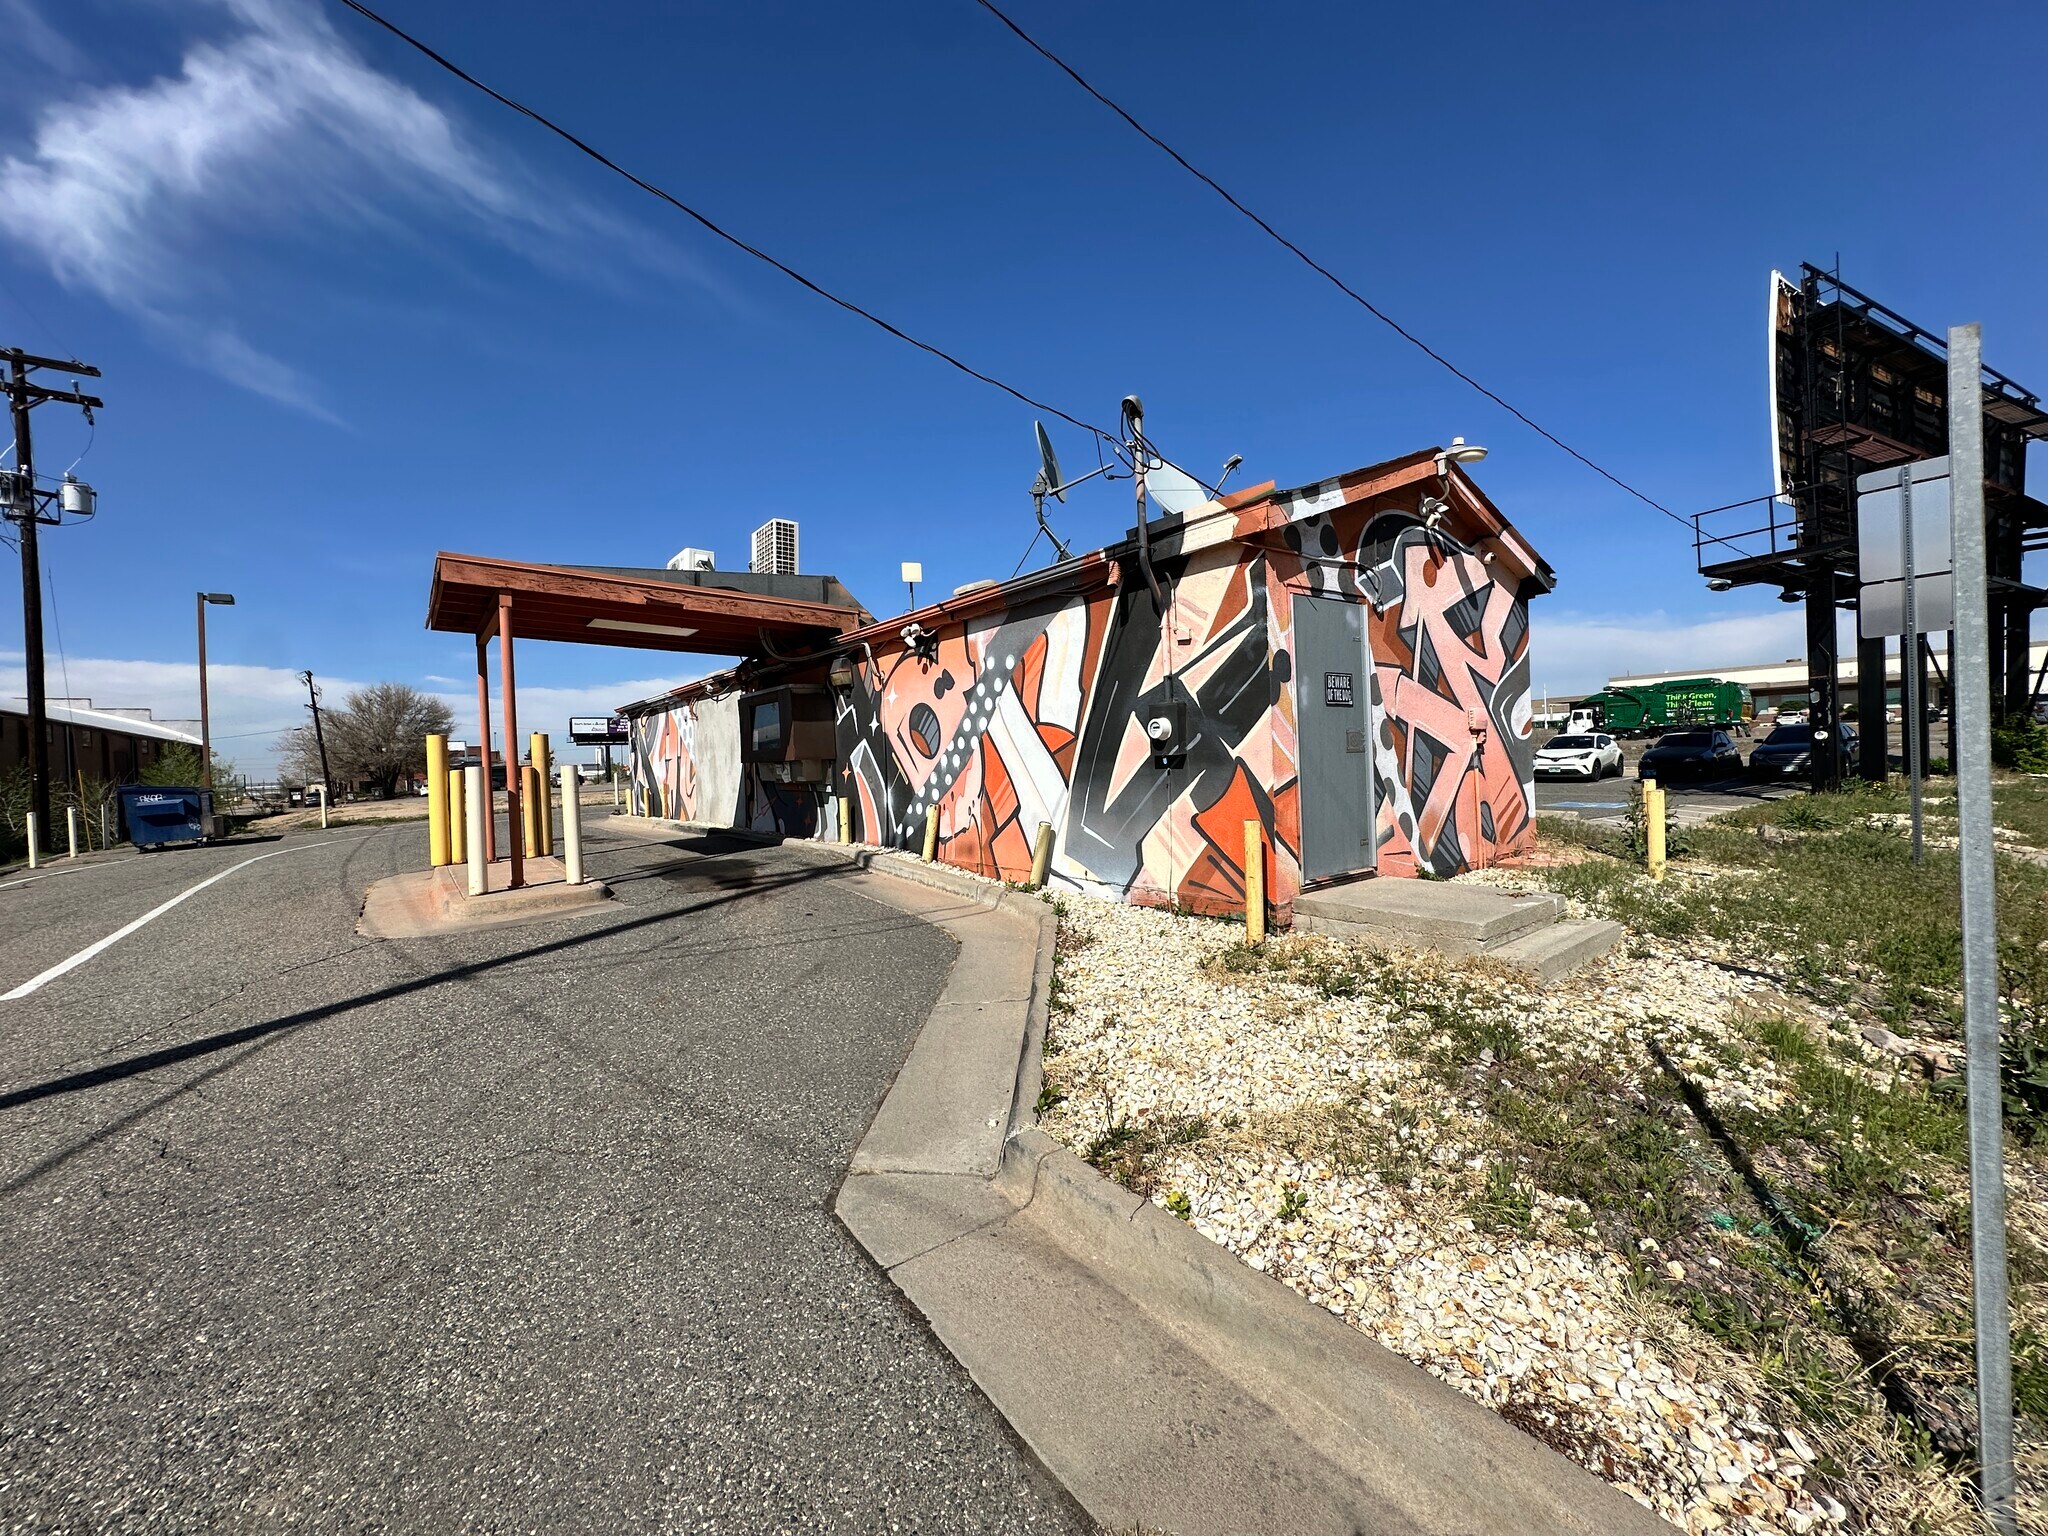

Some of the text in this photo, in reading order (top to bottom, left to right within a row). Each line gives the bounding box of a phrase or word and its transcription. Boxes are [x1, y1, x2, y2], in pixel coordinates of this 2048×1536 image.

[1327, 675, 1350, 689] BEWARE
[1327, 688, 1333, 701] OF
[1333, 688, 1342, 701] THE
[1688, 692, 1717, 700] Green,
